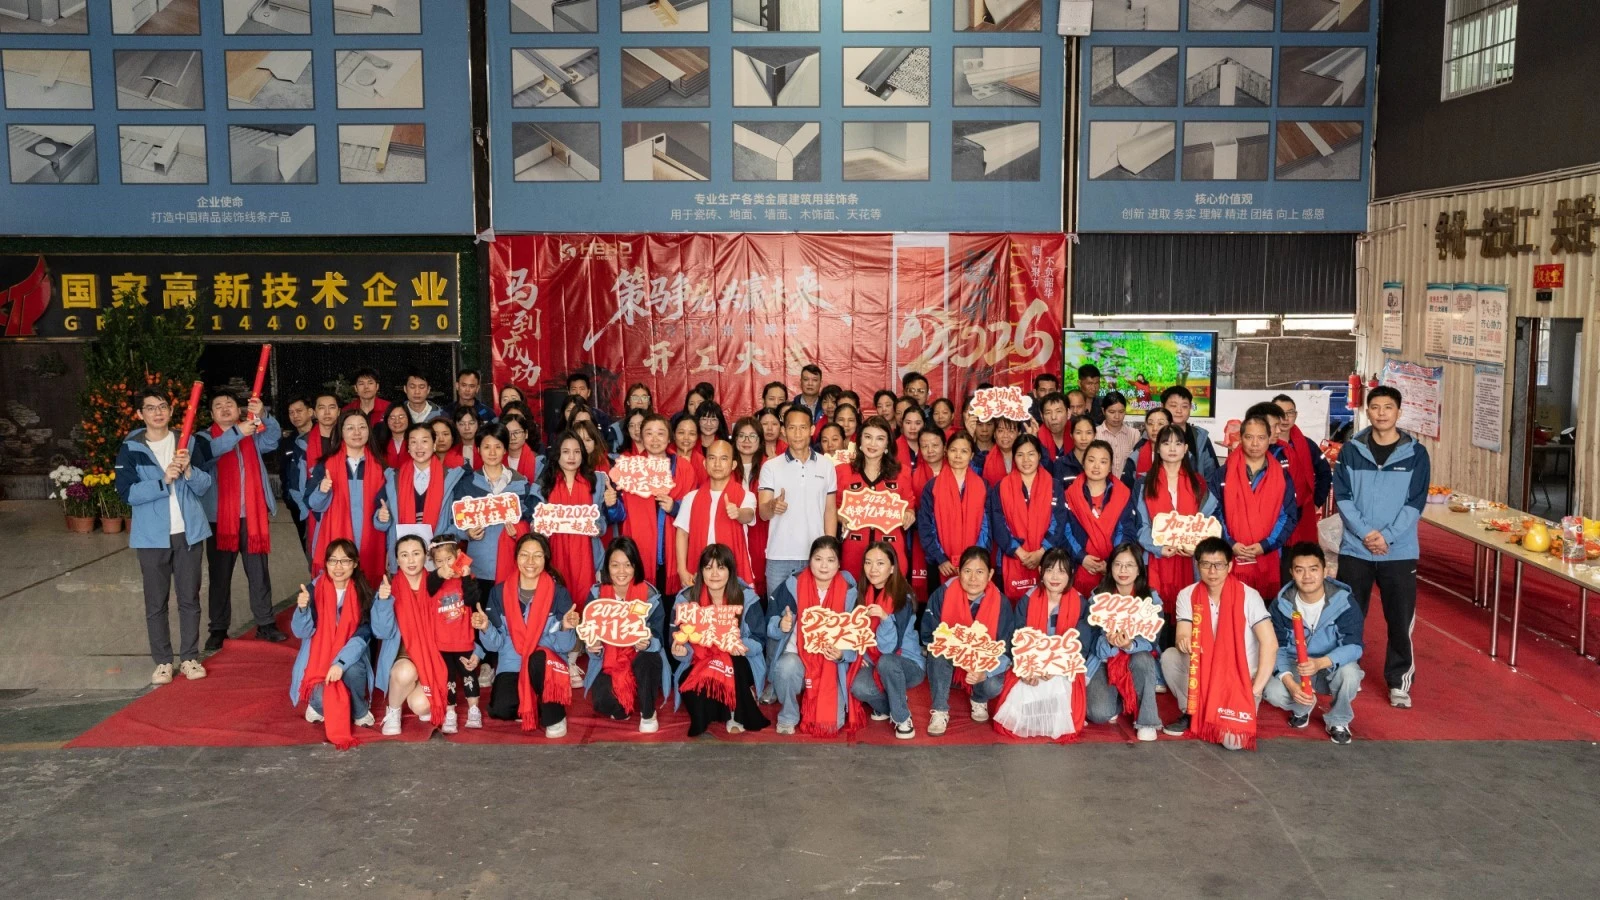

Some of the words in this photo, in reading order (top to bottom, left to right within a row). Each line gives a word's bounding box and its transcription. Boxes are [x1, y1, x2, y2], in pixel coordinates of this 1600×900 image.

[197, 196, 243, 208] 企业使命
[694, 193, 859, 206] 专业生产各类金属建筑用装饰条
[1194, 193, 1253, 205] 核心价值观
[151, 211, 292, 224] 打造中国精品装饰线条产品
[1122, 208, 1145, 220] 创新
[1148, 208, 1171, 220] 进取
[1173, 208, 1196, 220] 务实
[1199, 208, 1223, 220] 理解
[1225, 208, 1248, 220] 精进
[1250, 208, 1273, 220] 团结
[1276, 208, 1299, 220] 向上
[1302, 208, 1325, 220] 感恩
[61, 271, 449, 310] 国家高新技术企业
[64, 314, 448, 331] GR2144005730
[499, 268, 542, 387] 马到成功
[862, 493, 887, 504] 2026
[590, 603, 630, 618] 2026
[677, 603, 717, 625] 财源
[1092, 593, 1140, 614] 2026
[804, 607, 869, 633] 2026
[578, 619, 649, 646] 开门红
[701, 624, 746, 652] 滚滚
[1013, 630, 1080, 654] 2026
[930, 637, 998, 671] 马到成功
[1016, 651, 1085, 678] 爆大单
